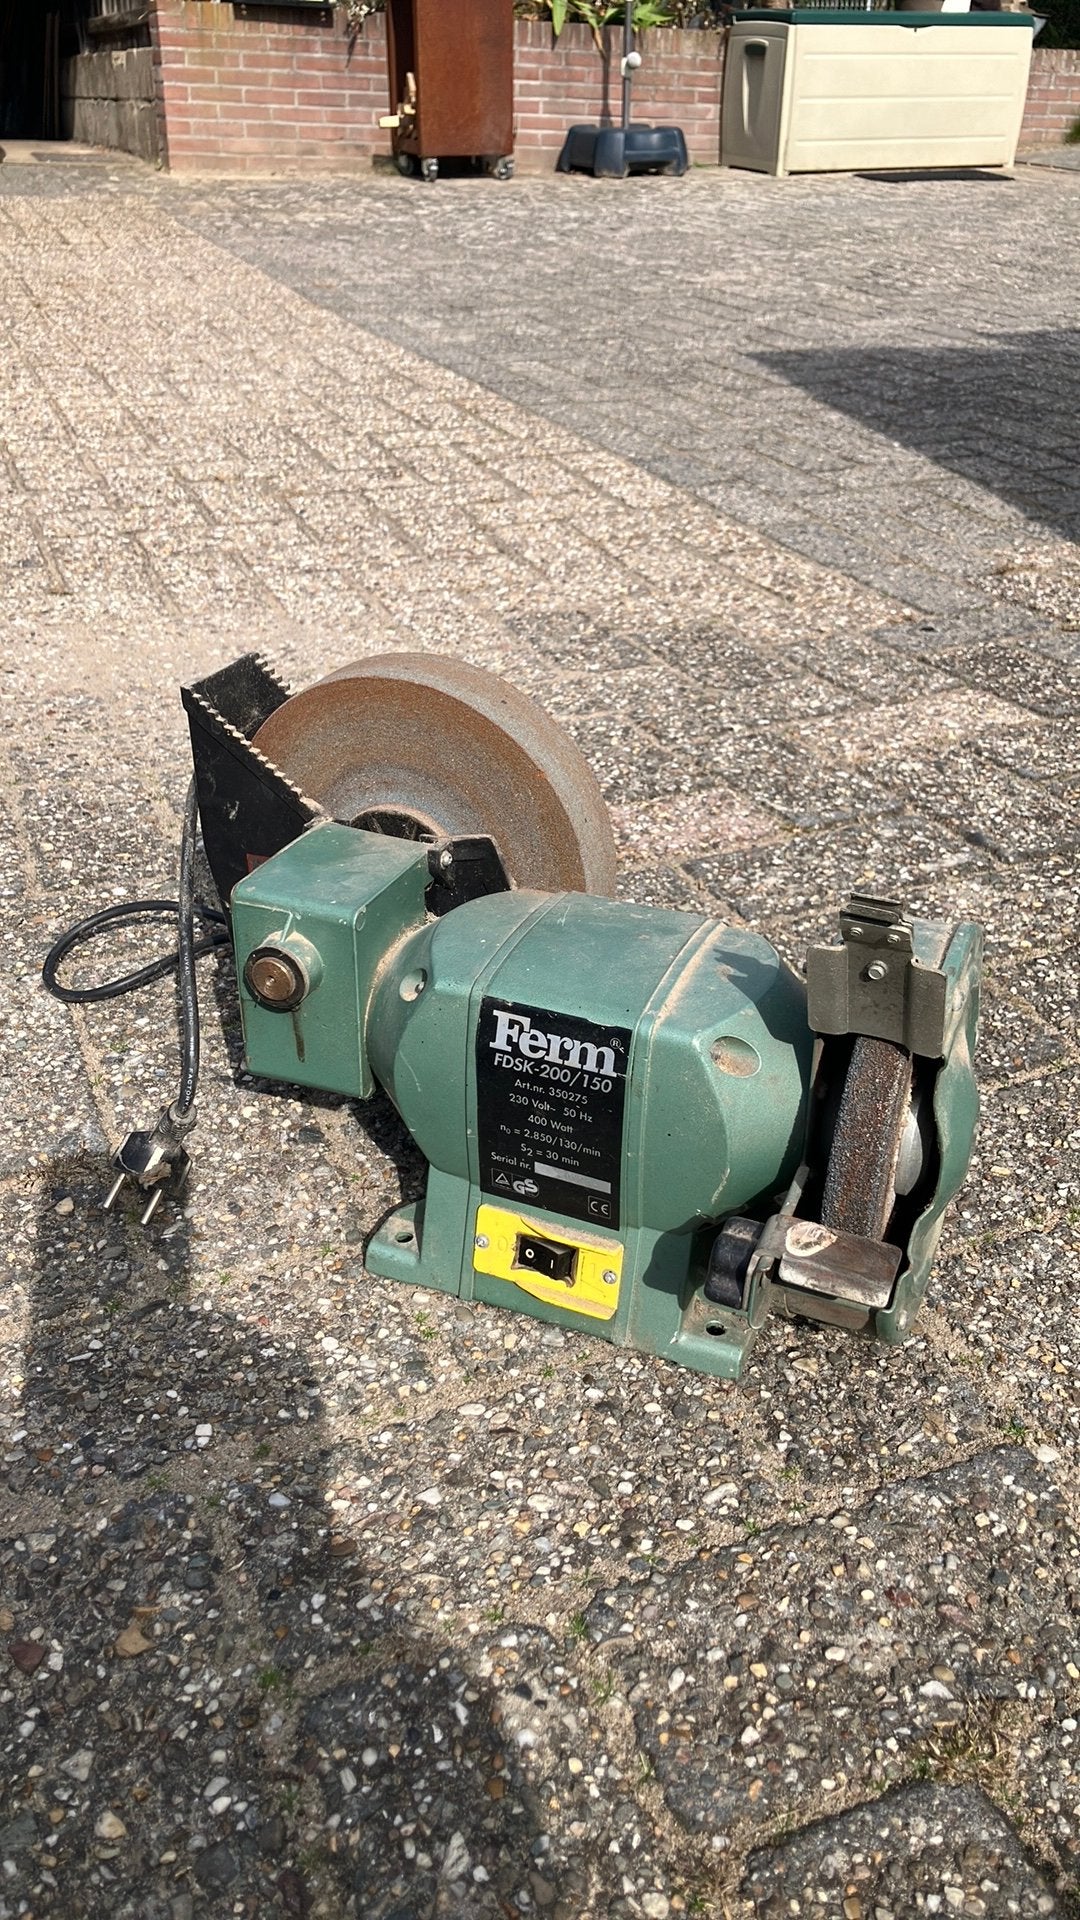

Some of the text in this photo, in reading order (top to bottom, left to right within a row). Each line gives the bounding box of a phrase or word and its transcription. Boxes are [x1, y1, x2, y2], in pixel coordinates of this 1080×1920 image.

[489, 1009, 617, 1078] Ferm
[494, 1053, 613, 1093] FDSK-200/150
[185, 1067, 194, 1106] FACTORY
[514, 1079, 588, 1105] Art.nr. 350275
[509, 1093, 529, 1106] 230
[563, 1107, 577, 1118] 50
[580, 1112, 593, 1123] Hz
[528, 1114, 574, 1134] 400 Watt
[524, 1128, 601, 1157] 2.850/130/min
[490, 1151, 532, 1170] Serial nr.
[545, 1150, 559, 1160] 30
[561, 1155, 580, 1167] min
[512, 1178, 539, 1195] GS
[590, 1201, 609, 1215] CE
